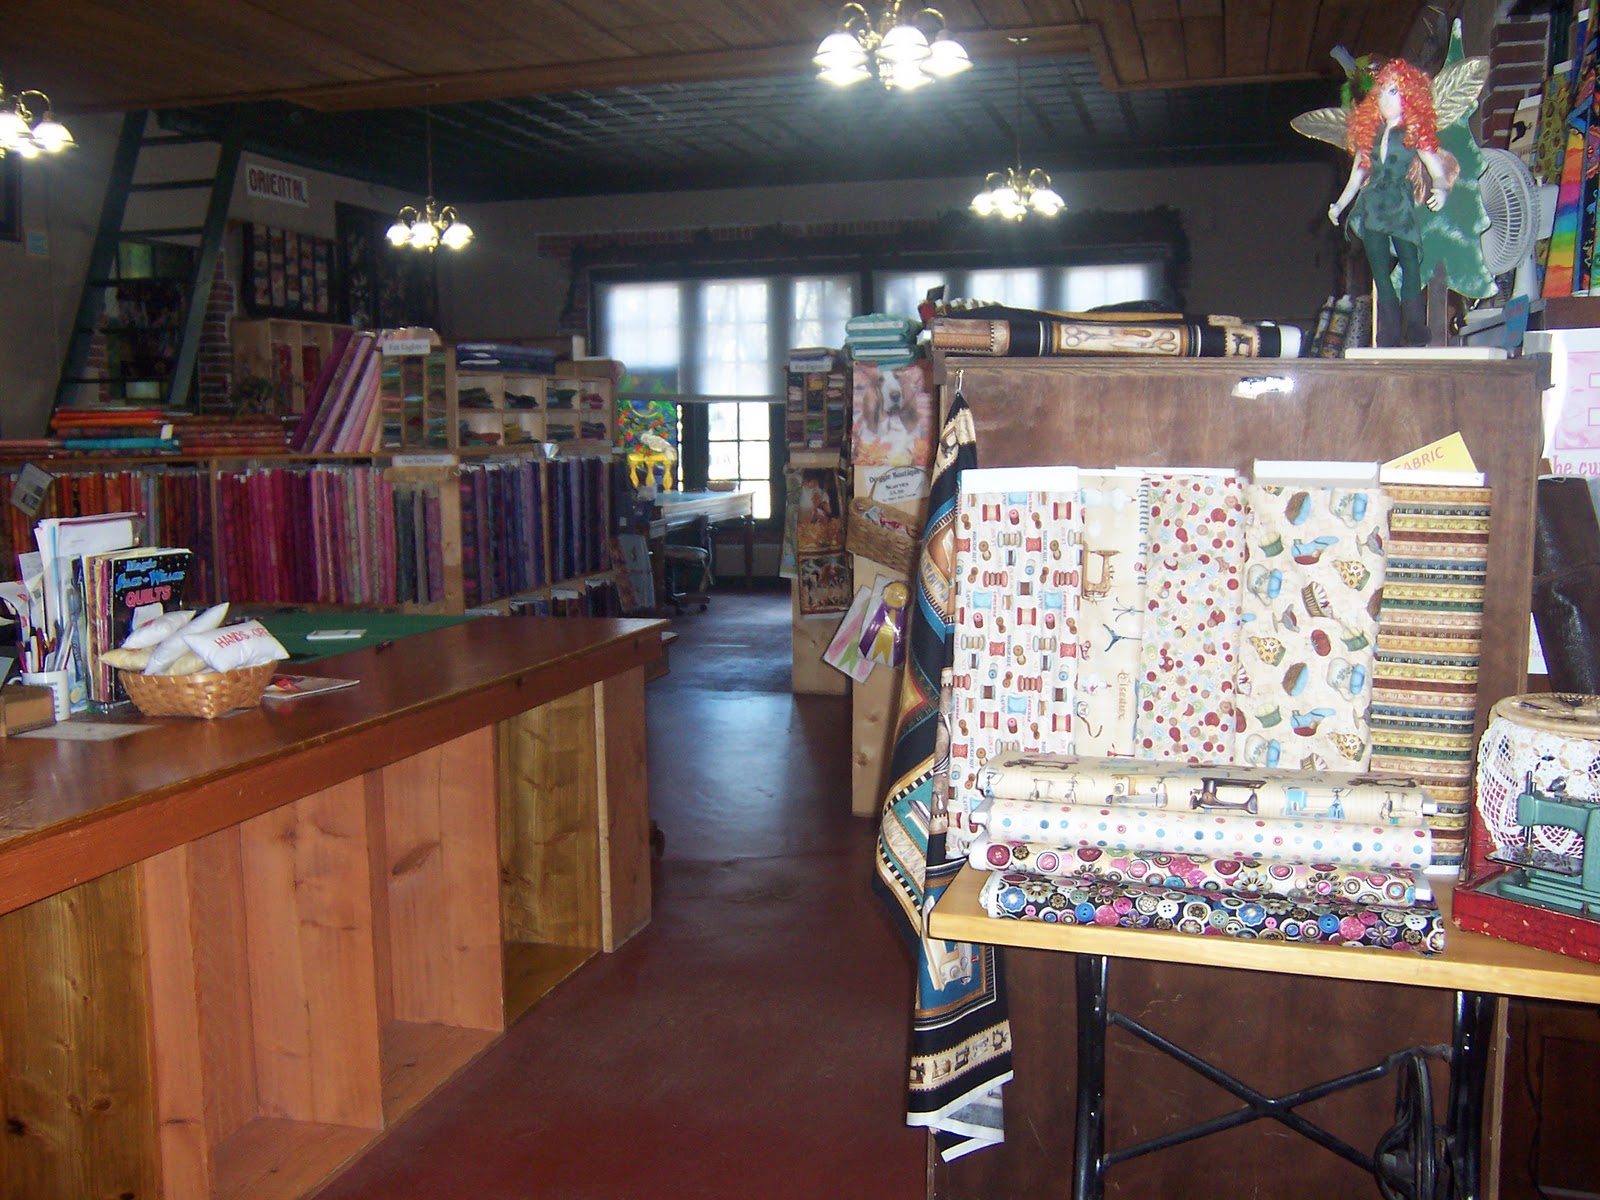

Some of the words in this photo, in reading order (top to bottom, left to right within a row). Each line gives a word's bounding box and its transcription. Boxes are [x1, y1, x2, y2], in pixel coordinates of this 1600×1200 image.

[248, 167, 307, 202] ORIENTAL
[1395, 446, 1444, 470] ABRIC
[1553, 455, 1573, 475] he
[1579, 461, 1600, 475] cu
[125, 584, 172, 608] QUILTS
[213, 630, 250, 648] HANDS
